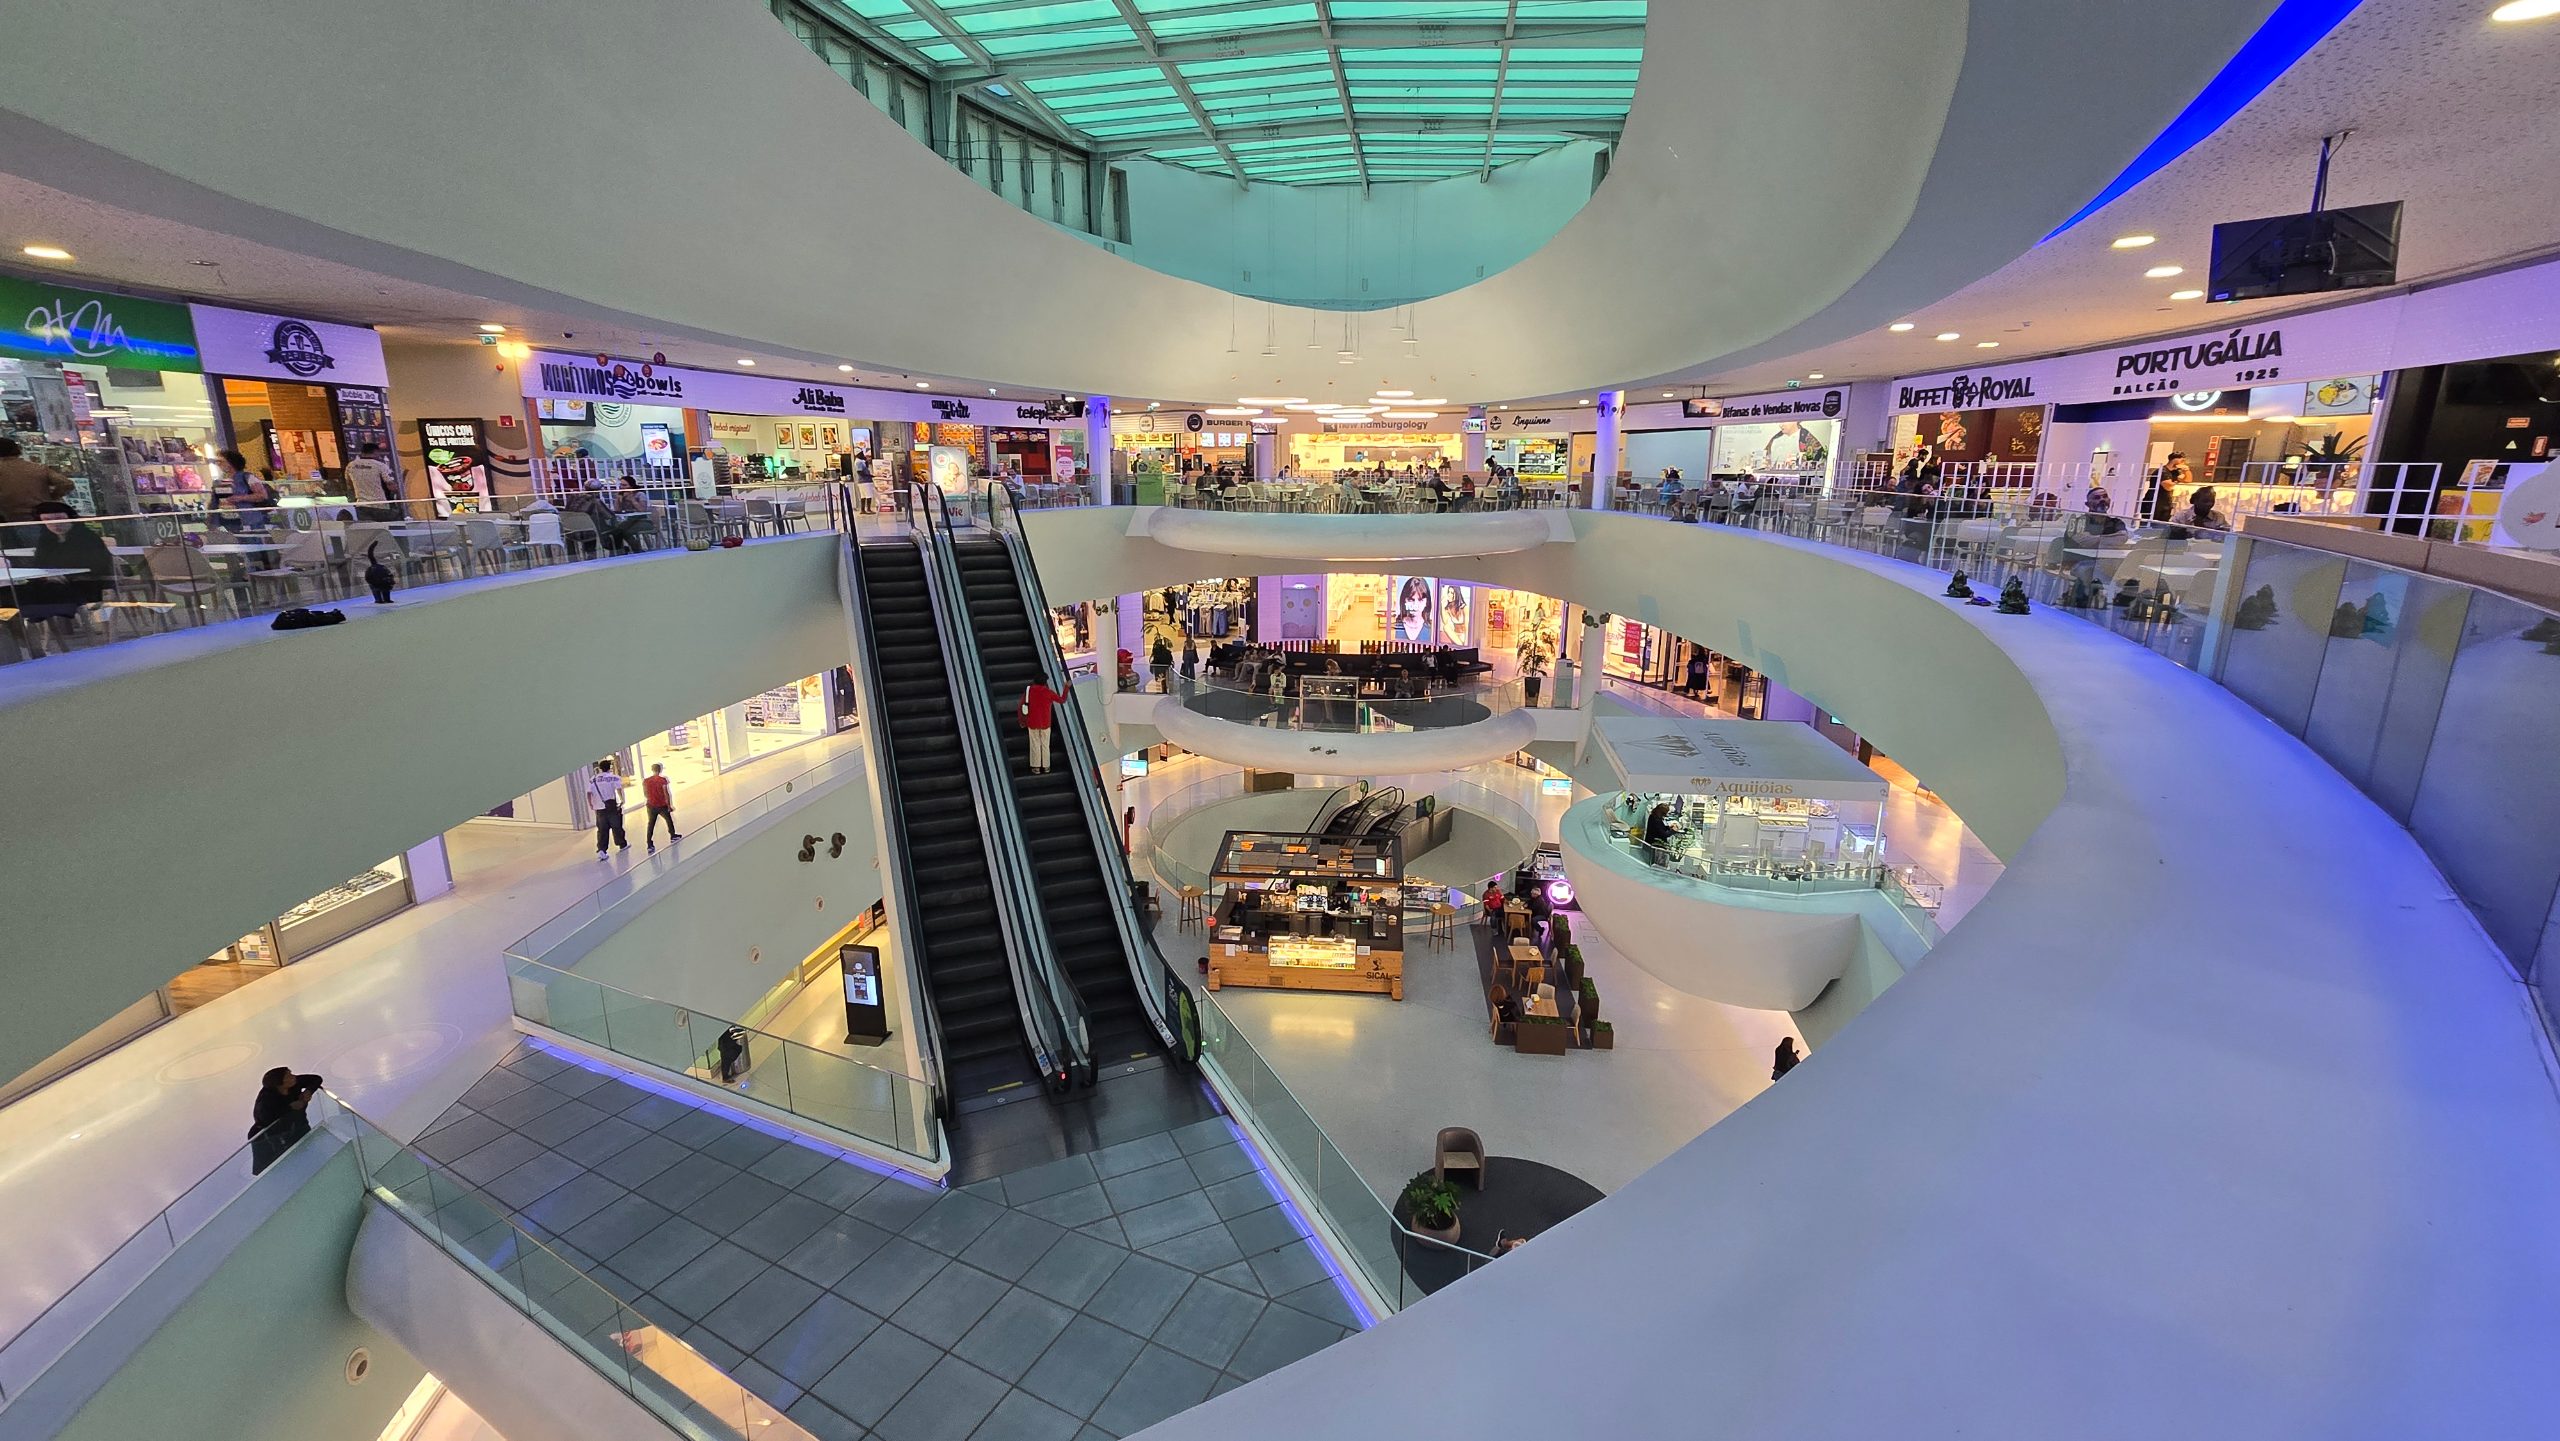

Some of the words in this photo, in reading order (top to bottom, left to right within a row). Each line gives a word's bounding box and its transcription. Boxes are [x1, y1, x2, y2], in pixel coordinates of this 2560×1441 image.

[2116, 329, 2283, 378] PORTUGÁLIA
[540, 361, 615, 396] MARÍTIMOS
[634, 371, 682, 393] bowls
[2113, 379, 2179, 395] BALCÃO
[2235, 367, 2279, 382] 1925
[792, 387, 815, 405] Ali
[815, 389, 845, 408] Baba
[1899, 386, 1952, 408] BUFFET
[1979, 377, 2035, 407] ROYAL
[1722, 405, 1750, 419] Bifanas
[1751, 404, 1761, 416] de
[1762, 402, 1793, 416] Vendas
[1794, 400, 1822, 413] Novas
[1716, 781, 1793, 796] Aquijóias
[1366, 971, 1391, 980] SICAL
